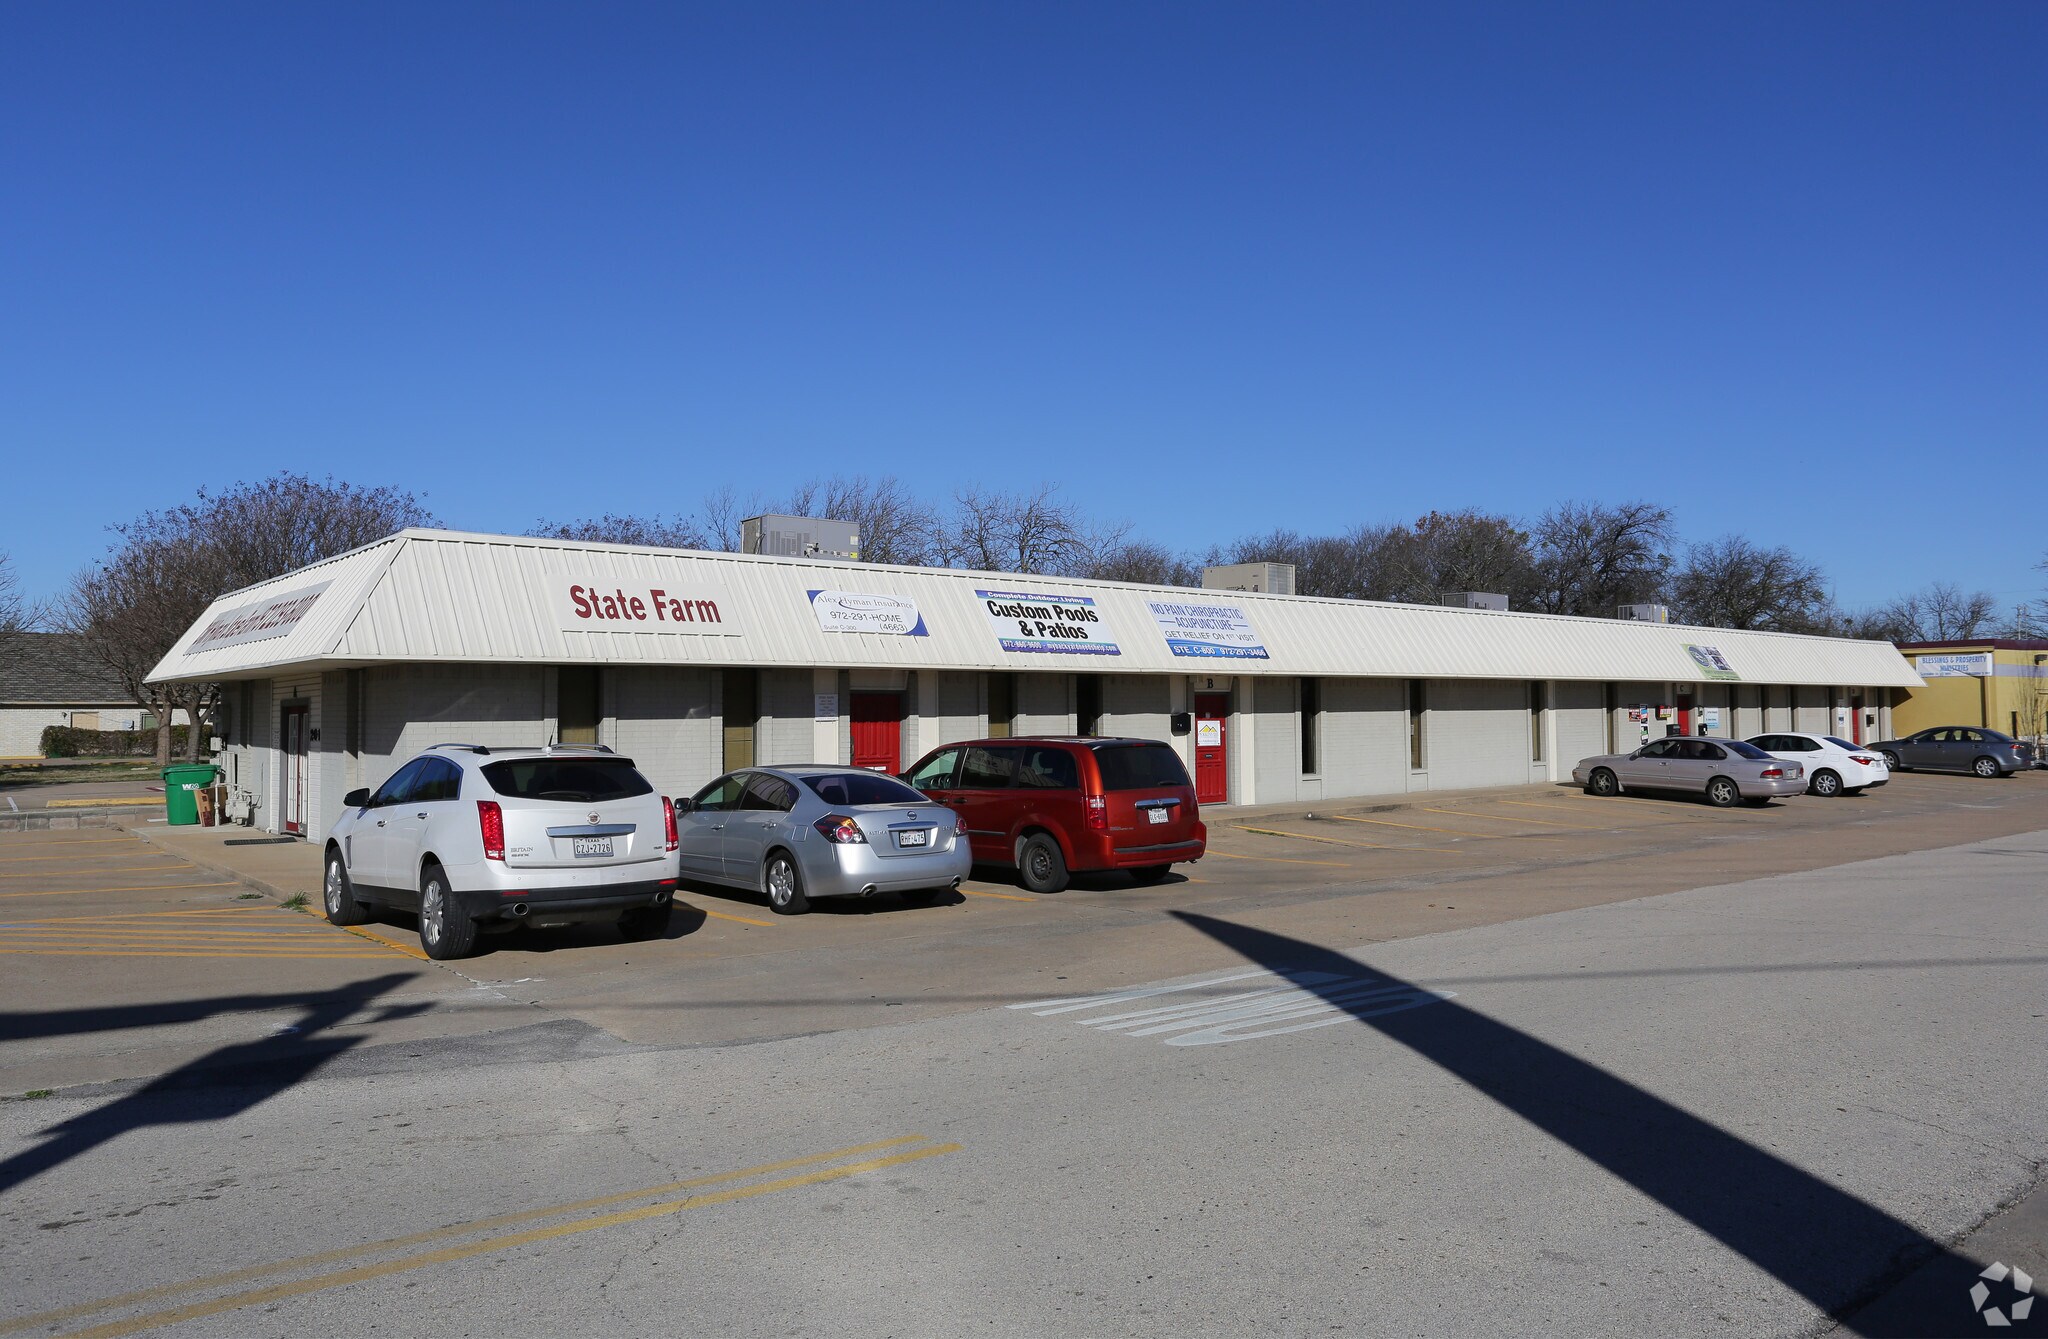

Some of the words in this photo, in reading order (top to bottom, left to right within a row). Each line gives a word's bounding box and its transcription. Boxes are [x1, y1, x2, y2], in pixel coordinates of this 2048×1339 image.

[987, 591, 1027, 600] Complete
[569, 585, 647, 621] State
[650, 589, 722, 623] Farm
[818, 596, 837, 604] Alex
[839, 597, 872, 607] Hyman
[873, 599, 914, 610] Insurance
[830, 611, 903, 623] 972-291-HOME
[986, 600, 1053, 620] Custom
[1051, 604, 1099, 622] Pools
[1150, 603, 1165, 614] NO
[1163, 604, 1186, 616] PAIN
[1184, 605, 1244, 620] CHIROPRACTIC
[1018, 620, 1035, 637] &
[1034, 621, 1089, 639] Patios
[1175, 617, 1235, 631] ACUPUNCTURE
[1165, 630, 1182, 638] GET
[1183, 631, 1211, 640] RELIEF
[1212, 632, 1226, 640] ON
[1235, 633, 1256, 642] VISIT
[1173, 645, 1194, 654] STE.
[1922, 656, 1949, 664] BLESSINGS
[1956, 655, 1987, 663] PROSPERITY
[1206, 678, 1214, 689] B
